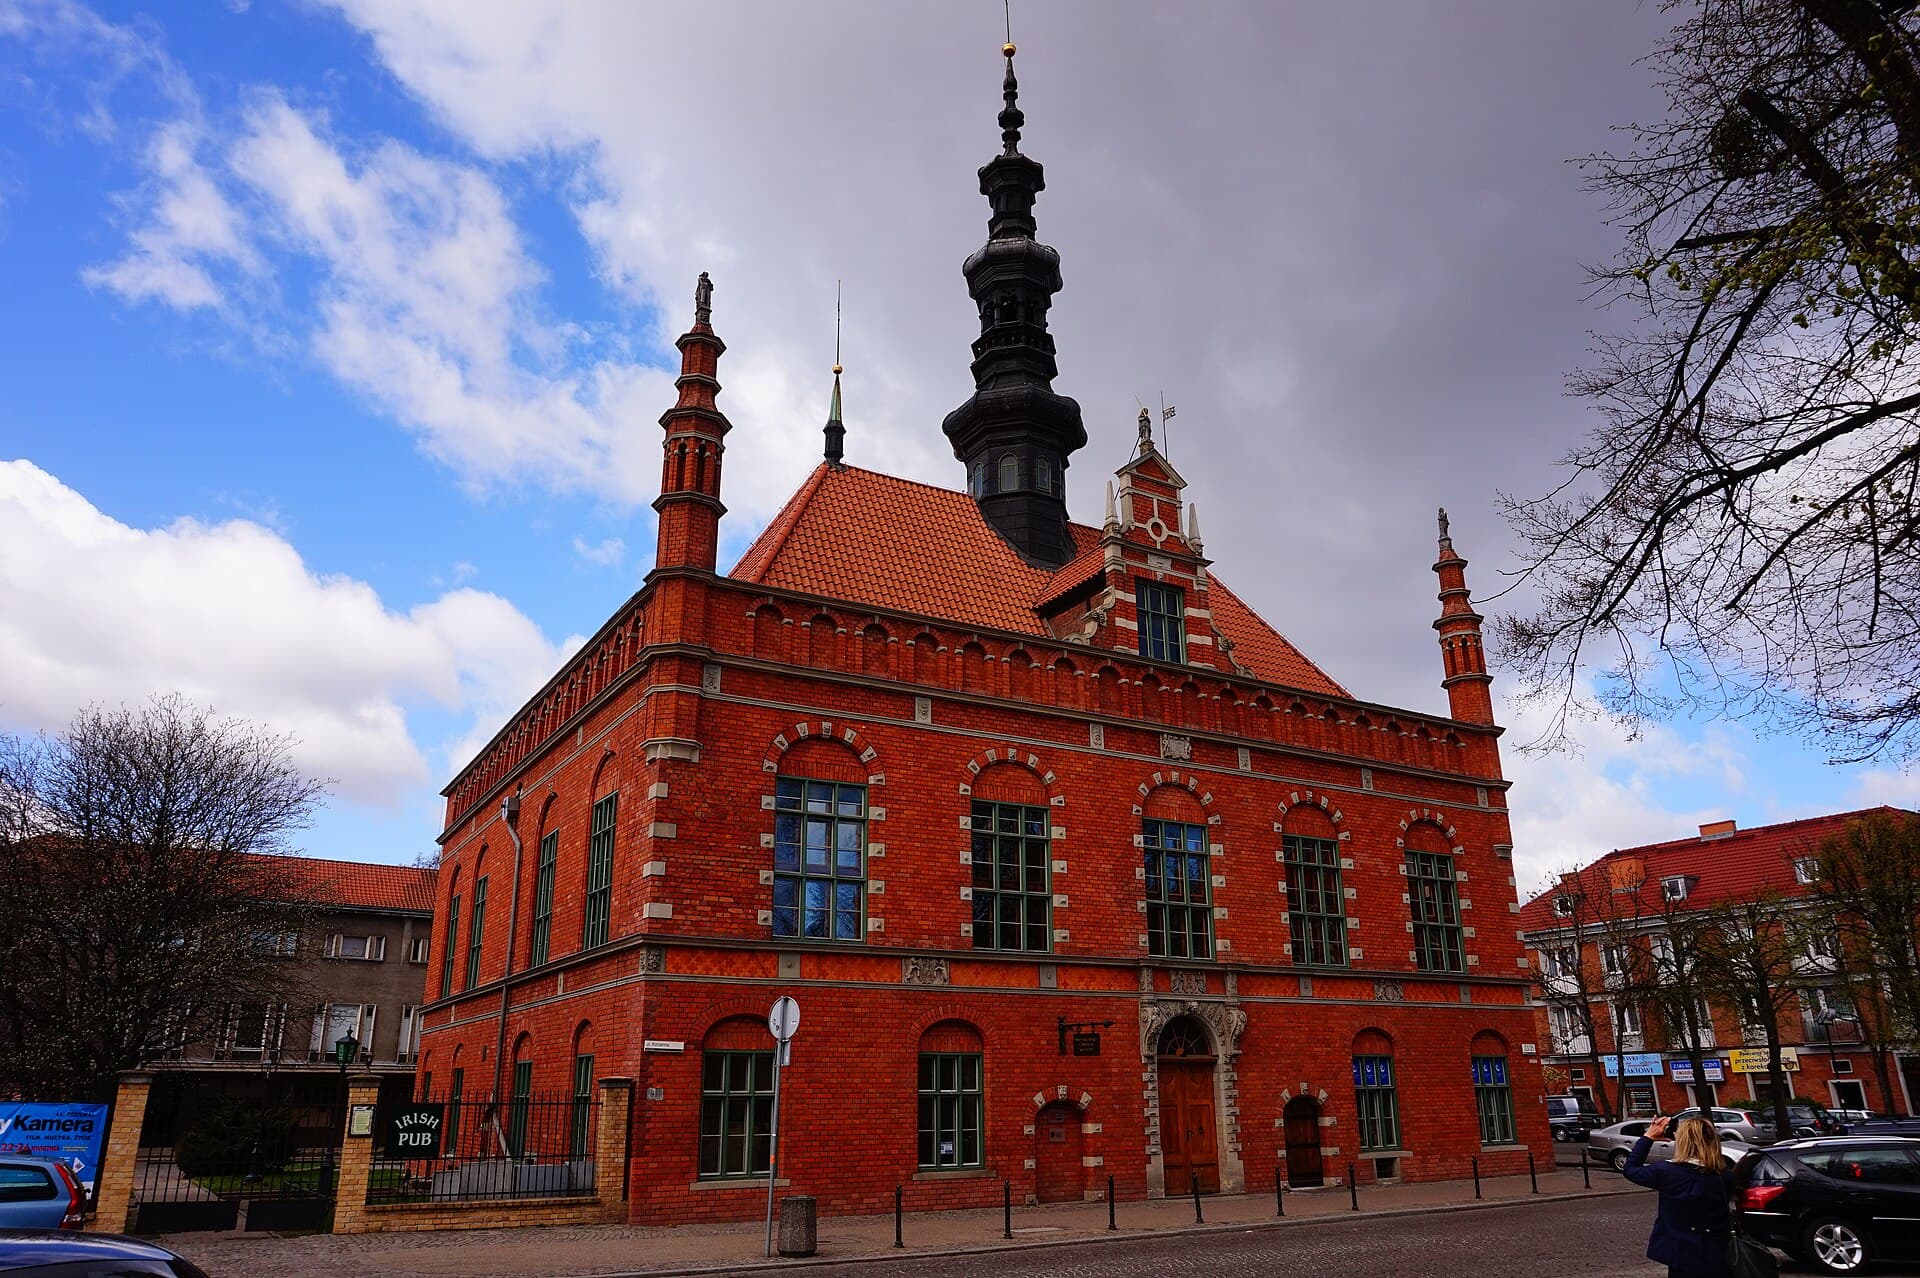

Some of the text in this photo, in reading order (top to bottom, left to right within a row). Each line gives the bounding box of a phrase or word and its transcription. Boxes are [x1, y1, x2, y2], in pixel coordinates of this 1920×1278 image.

[14, 1115, 94, 1132] Kamera
[395, 1112, 440, 1130] IRISH
[398, 1132, 432, 1146] PUB
